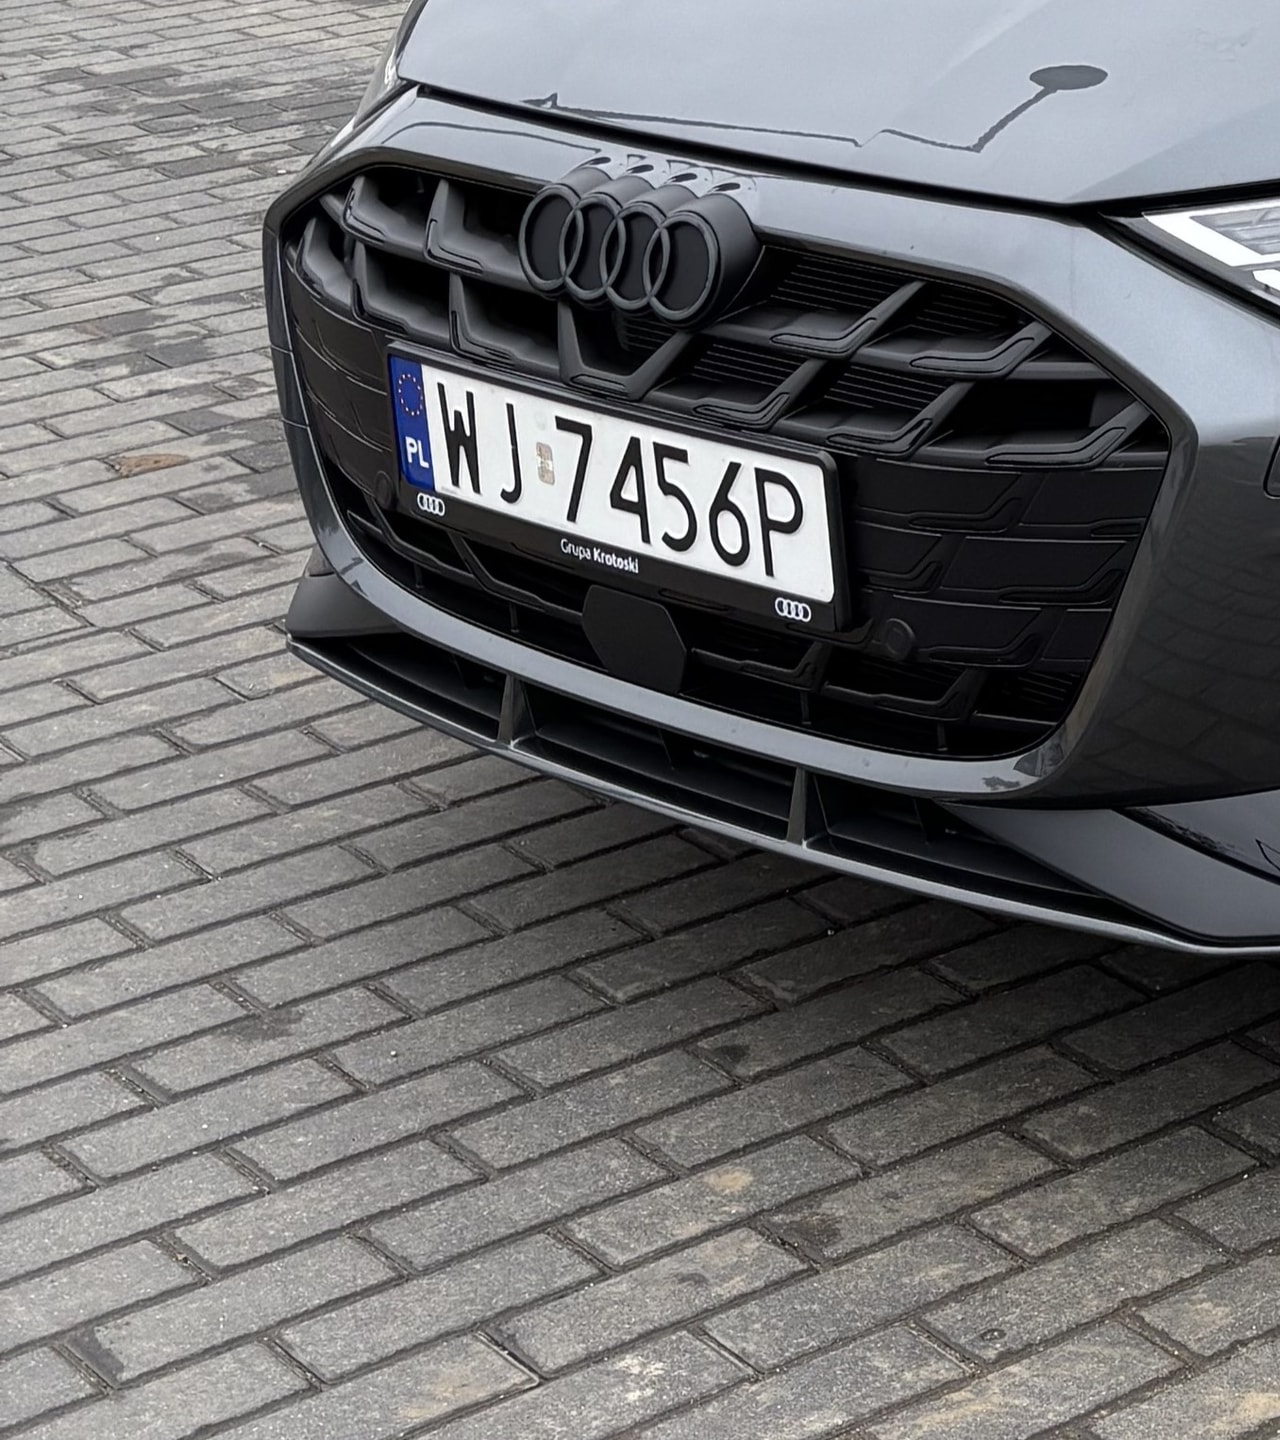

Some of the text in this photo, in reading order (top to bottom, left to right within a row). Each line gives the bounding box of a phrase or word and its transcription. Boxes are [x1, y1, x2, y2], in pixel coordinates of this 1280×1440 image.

[405, 435, 430, 470] PL
[437, 382, 804, 578] WJ 7456P
[560, 538, 639, 574] Grupa Krotoski
